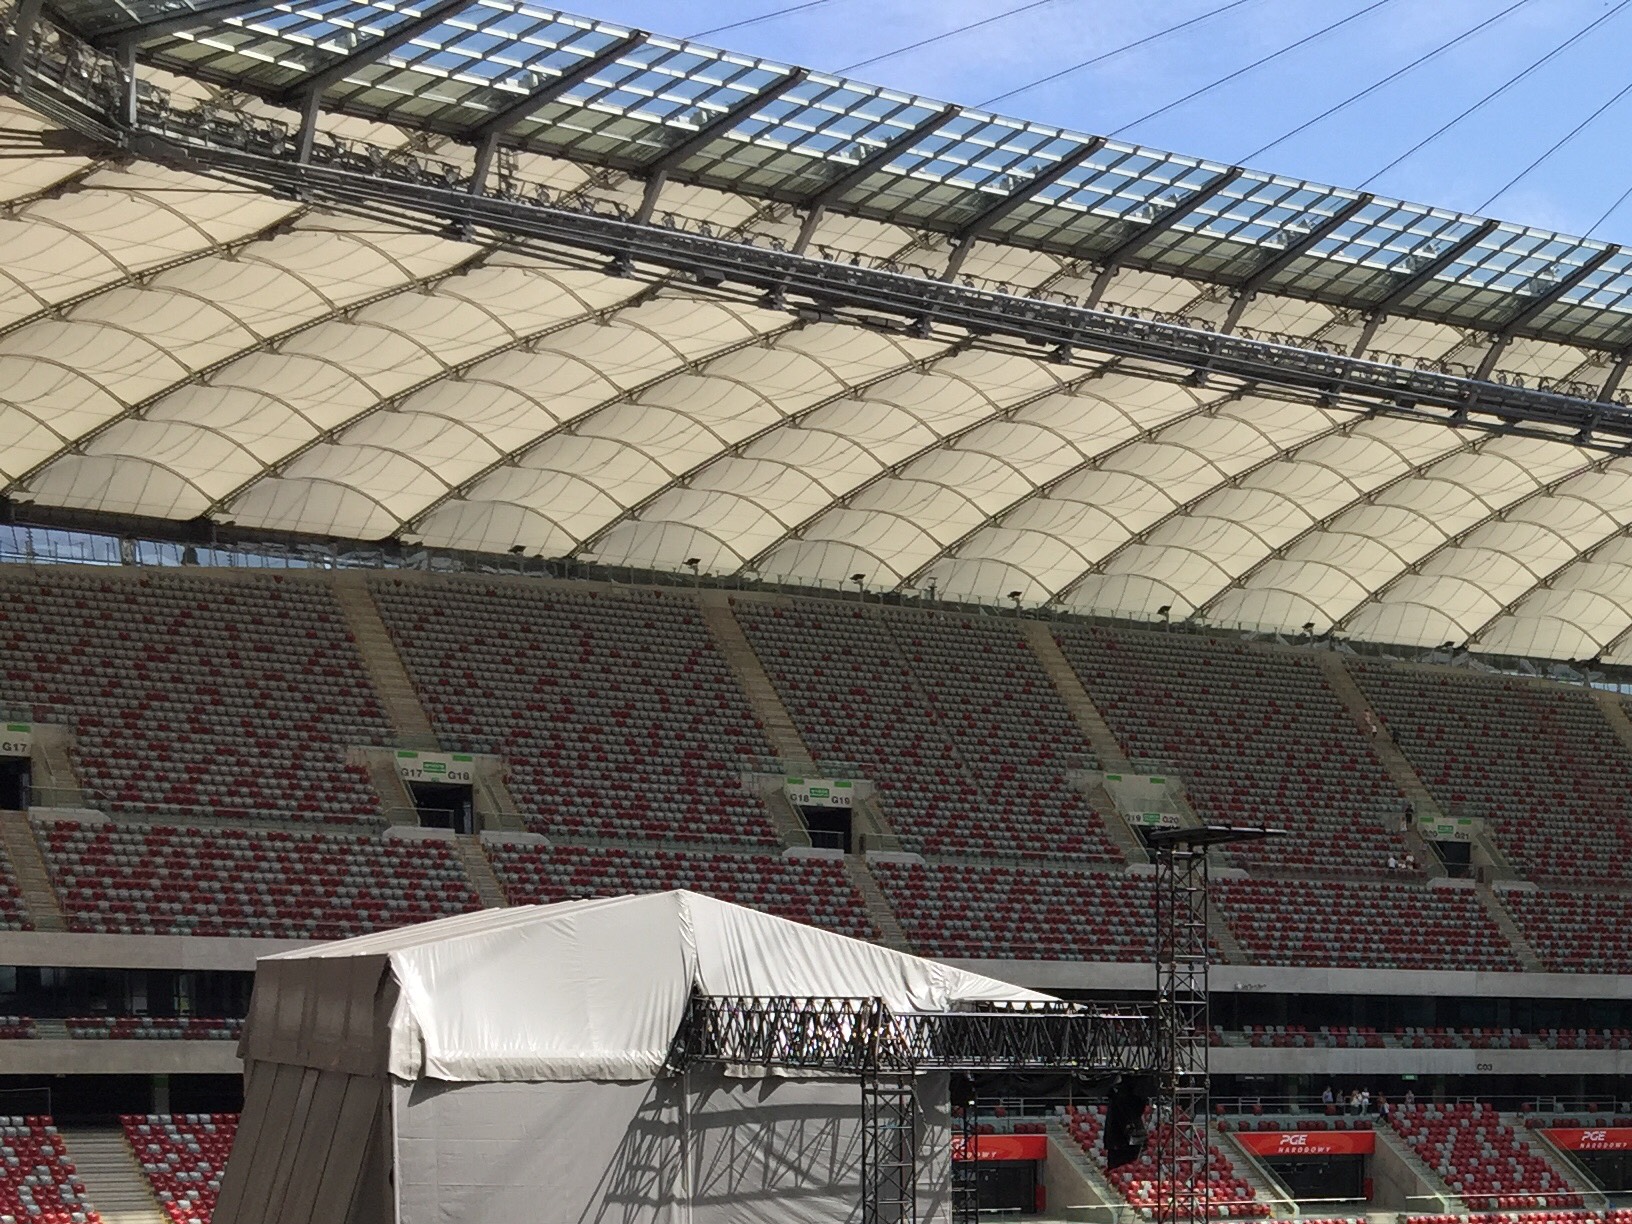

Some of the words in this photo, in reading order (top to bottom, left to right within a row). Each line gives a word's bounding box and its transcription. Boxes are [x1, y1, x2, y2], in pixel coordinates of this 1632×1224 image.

[2, 741, 28, 752] G17
[1280, 1134, 1308, 1145] PGE
[1580, 1130, 1607, 1141] PGE
